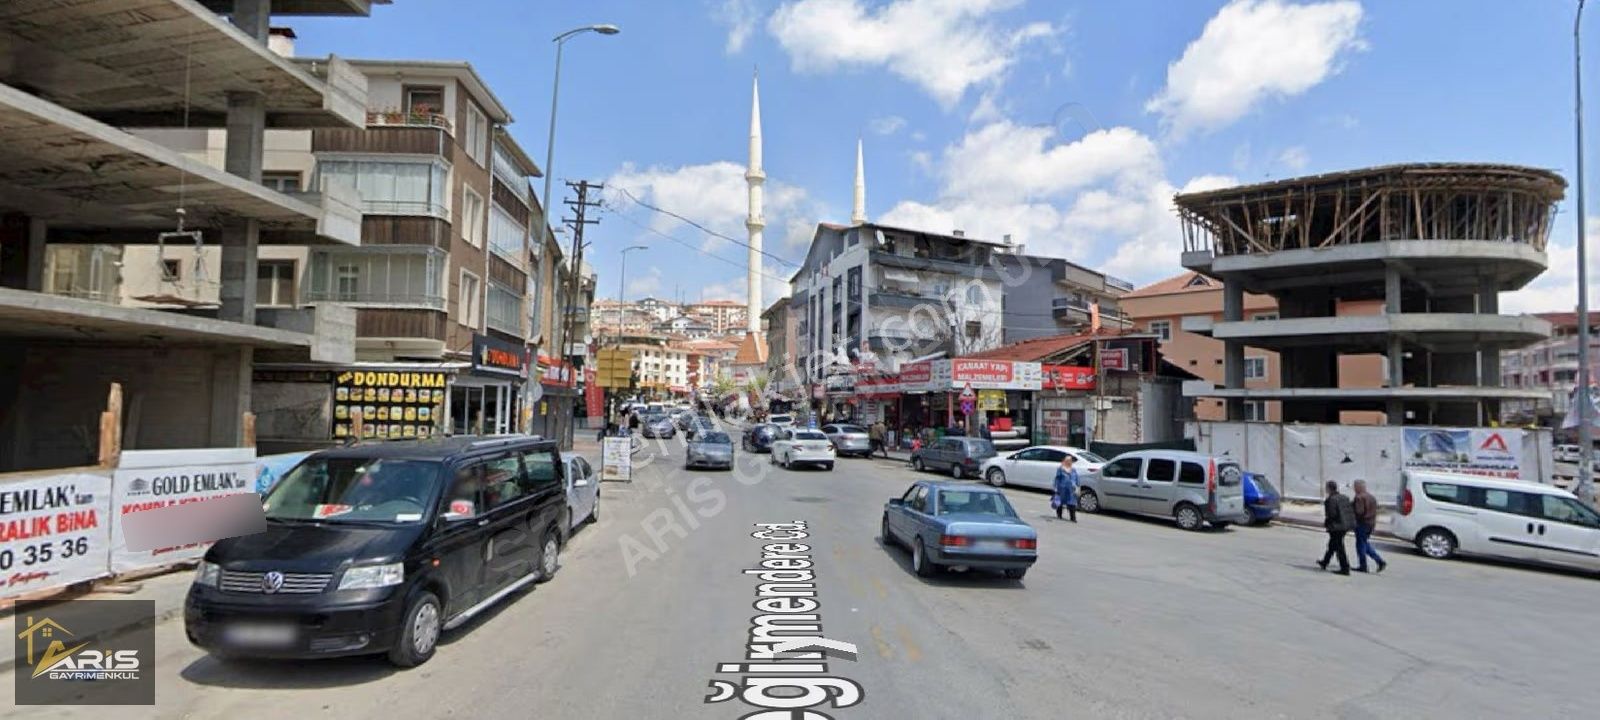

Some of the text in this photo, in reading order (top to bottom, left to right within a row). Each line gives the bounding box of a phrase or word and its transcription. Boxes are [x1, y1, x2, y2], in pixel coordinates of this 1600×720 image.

[354, 371, 445, 388] DONDURMA
[152, 475, 190, 496] GOLD
[23, 541, 53, 566] 35
[61, 536, 90, 560] 36
